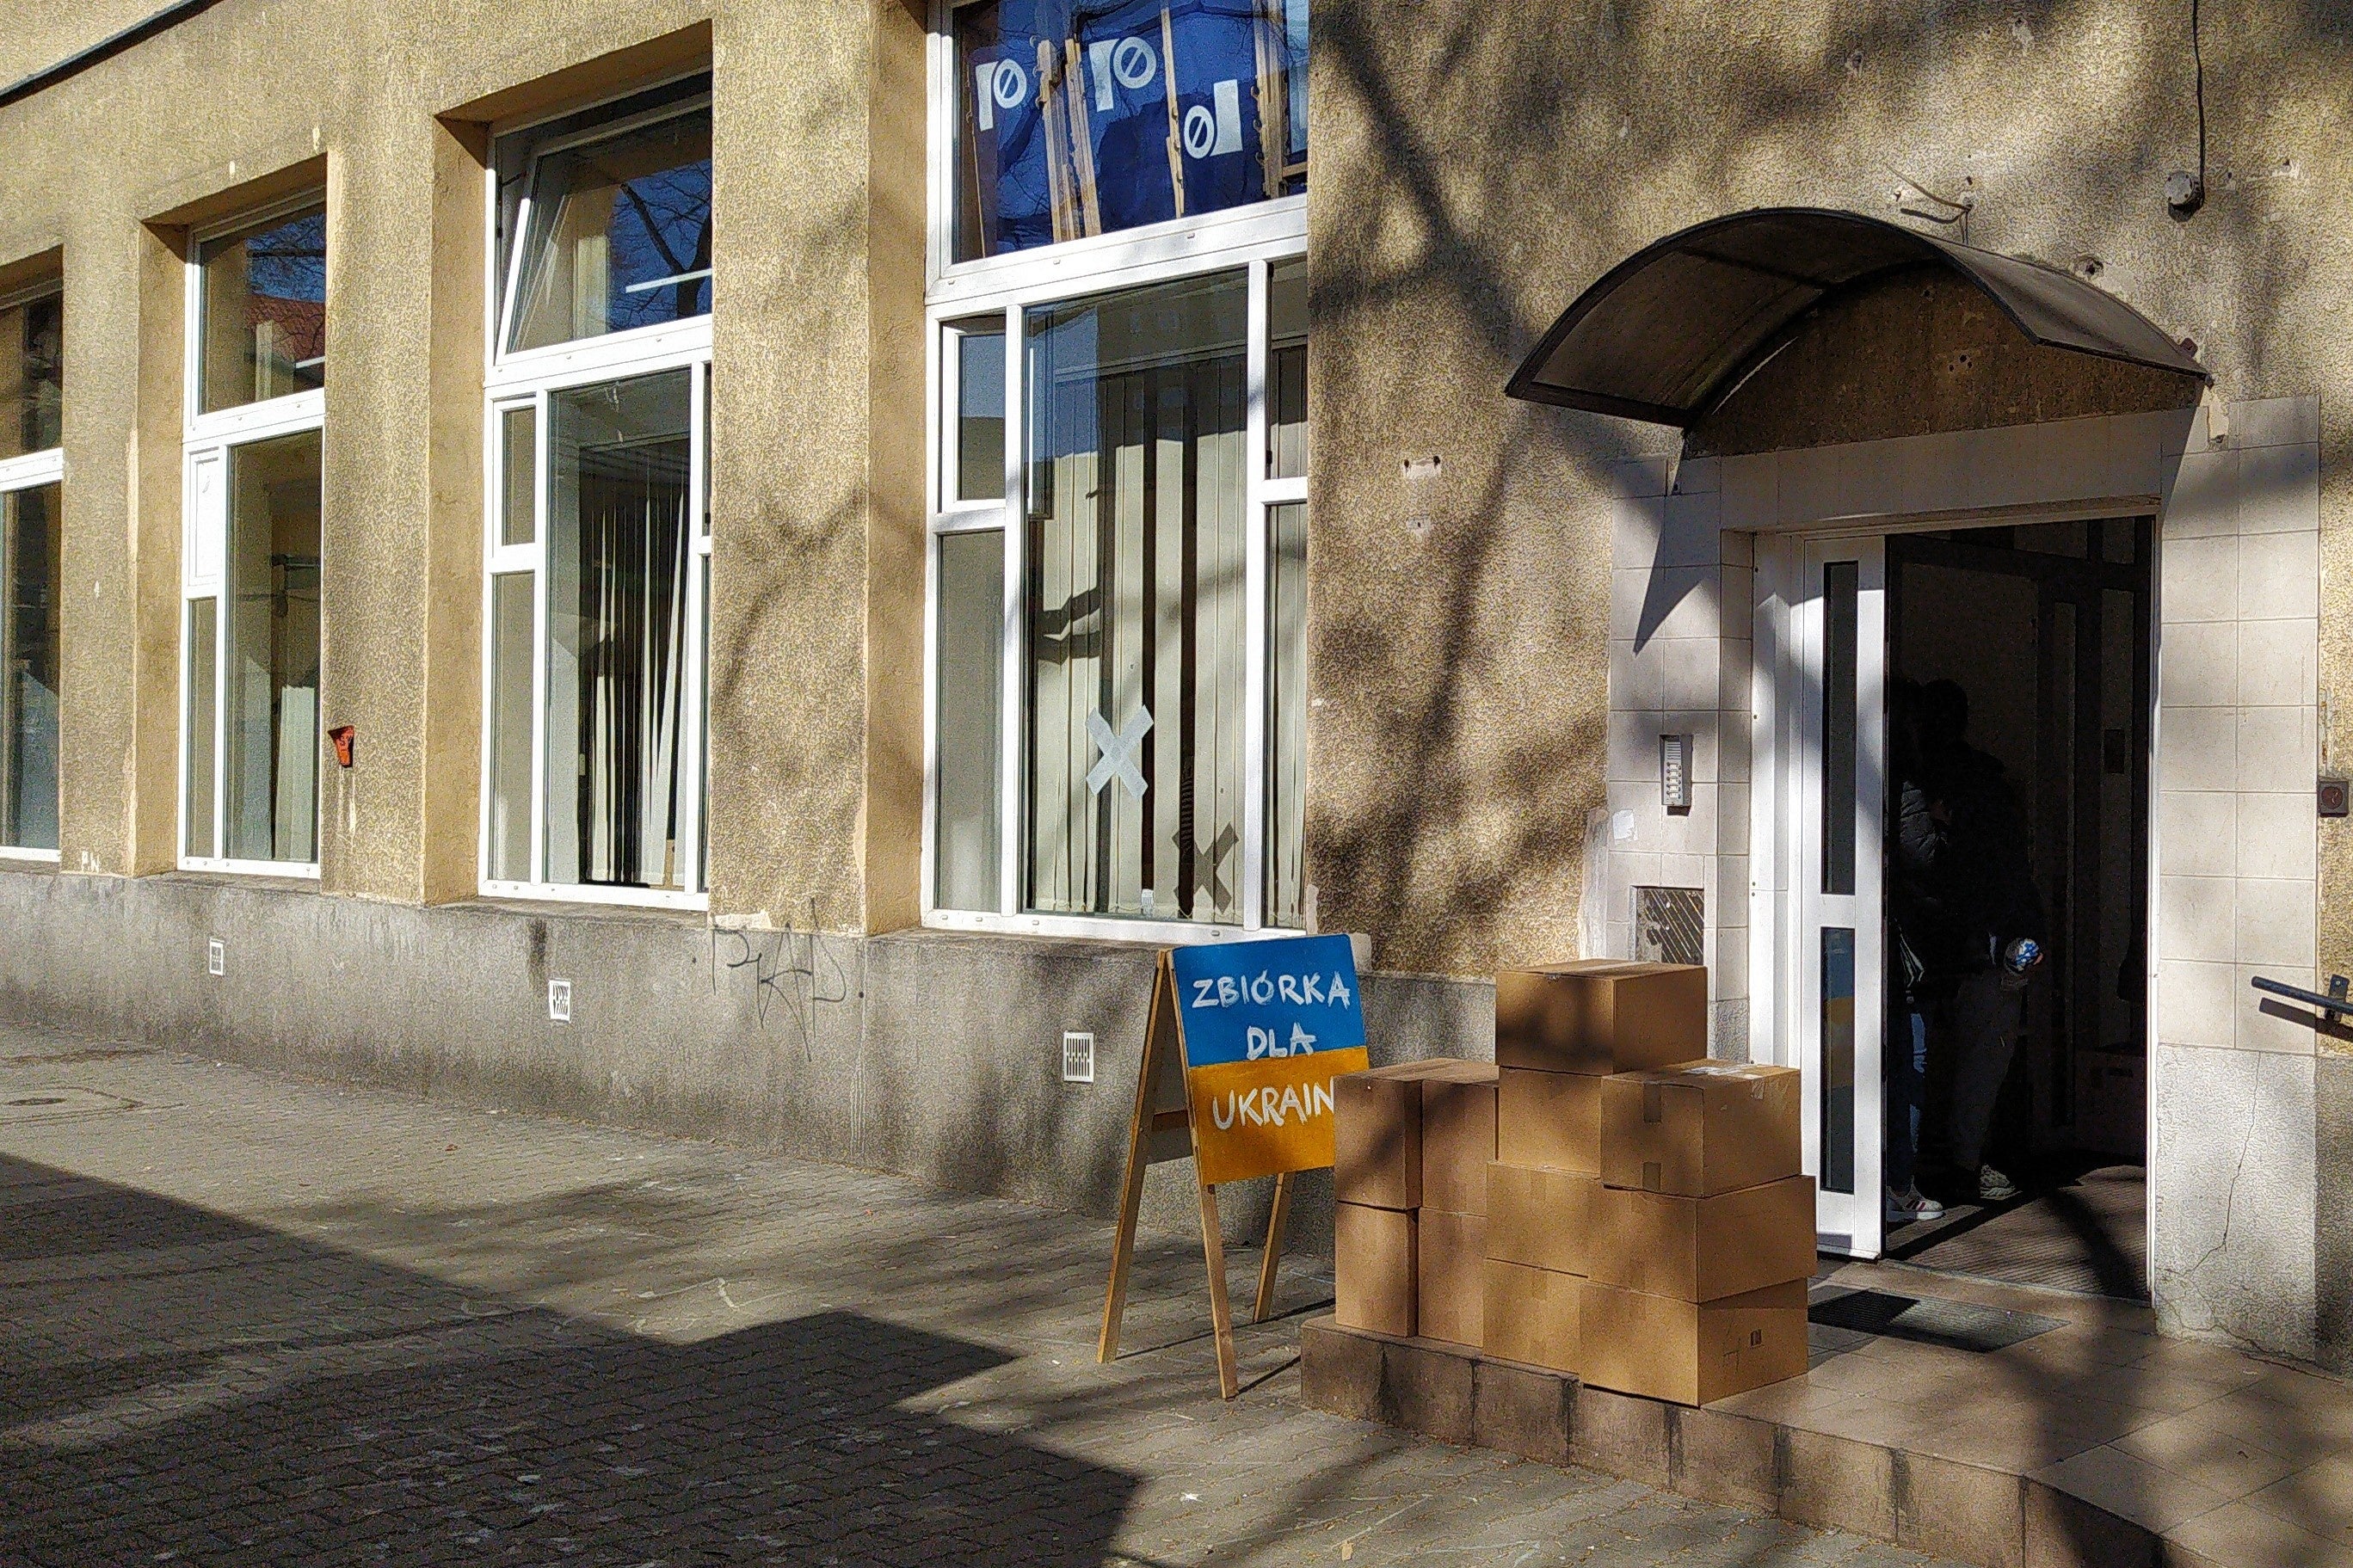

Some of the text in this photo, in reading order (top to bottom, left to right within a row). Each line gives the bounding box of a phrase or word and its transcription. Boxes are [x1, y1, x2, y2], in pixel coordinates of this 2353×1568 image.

[1192, 969, 1350, 1009] ZBIÓRKA
[1247, 1023, 1316, 1061] DLA
[1213, 1075, 1334, 1129] UKRAIN
